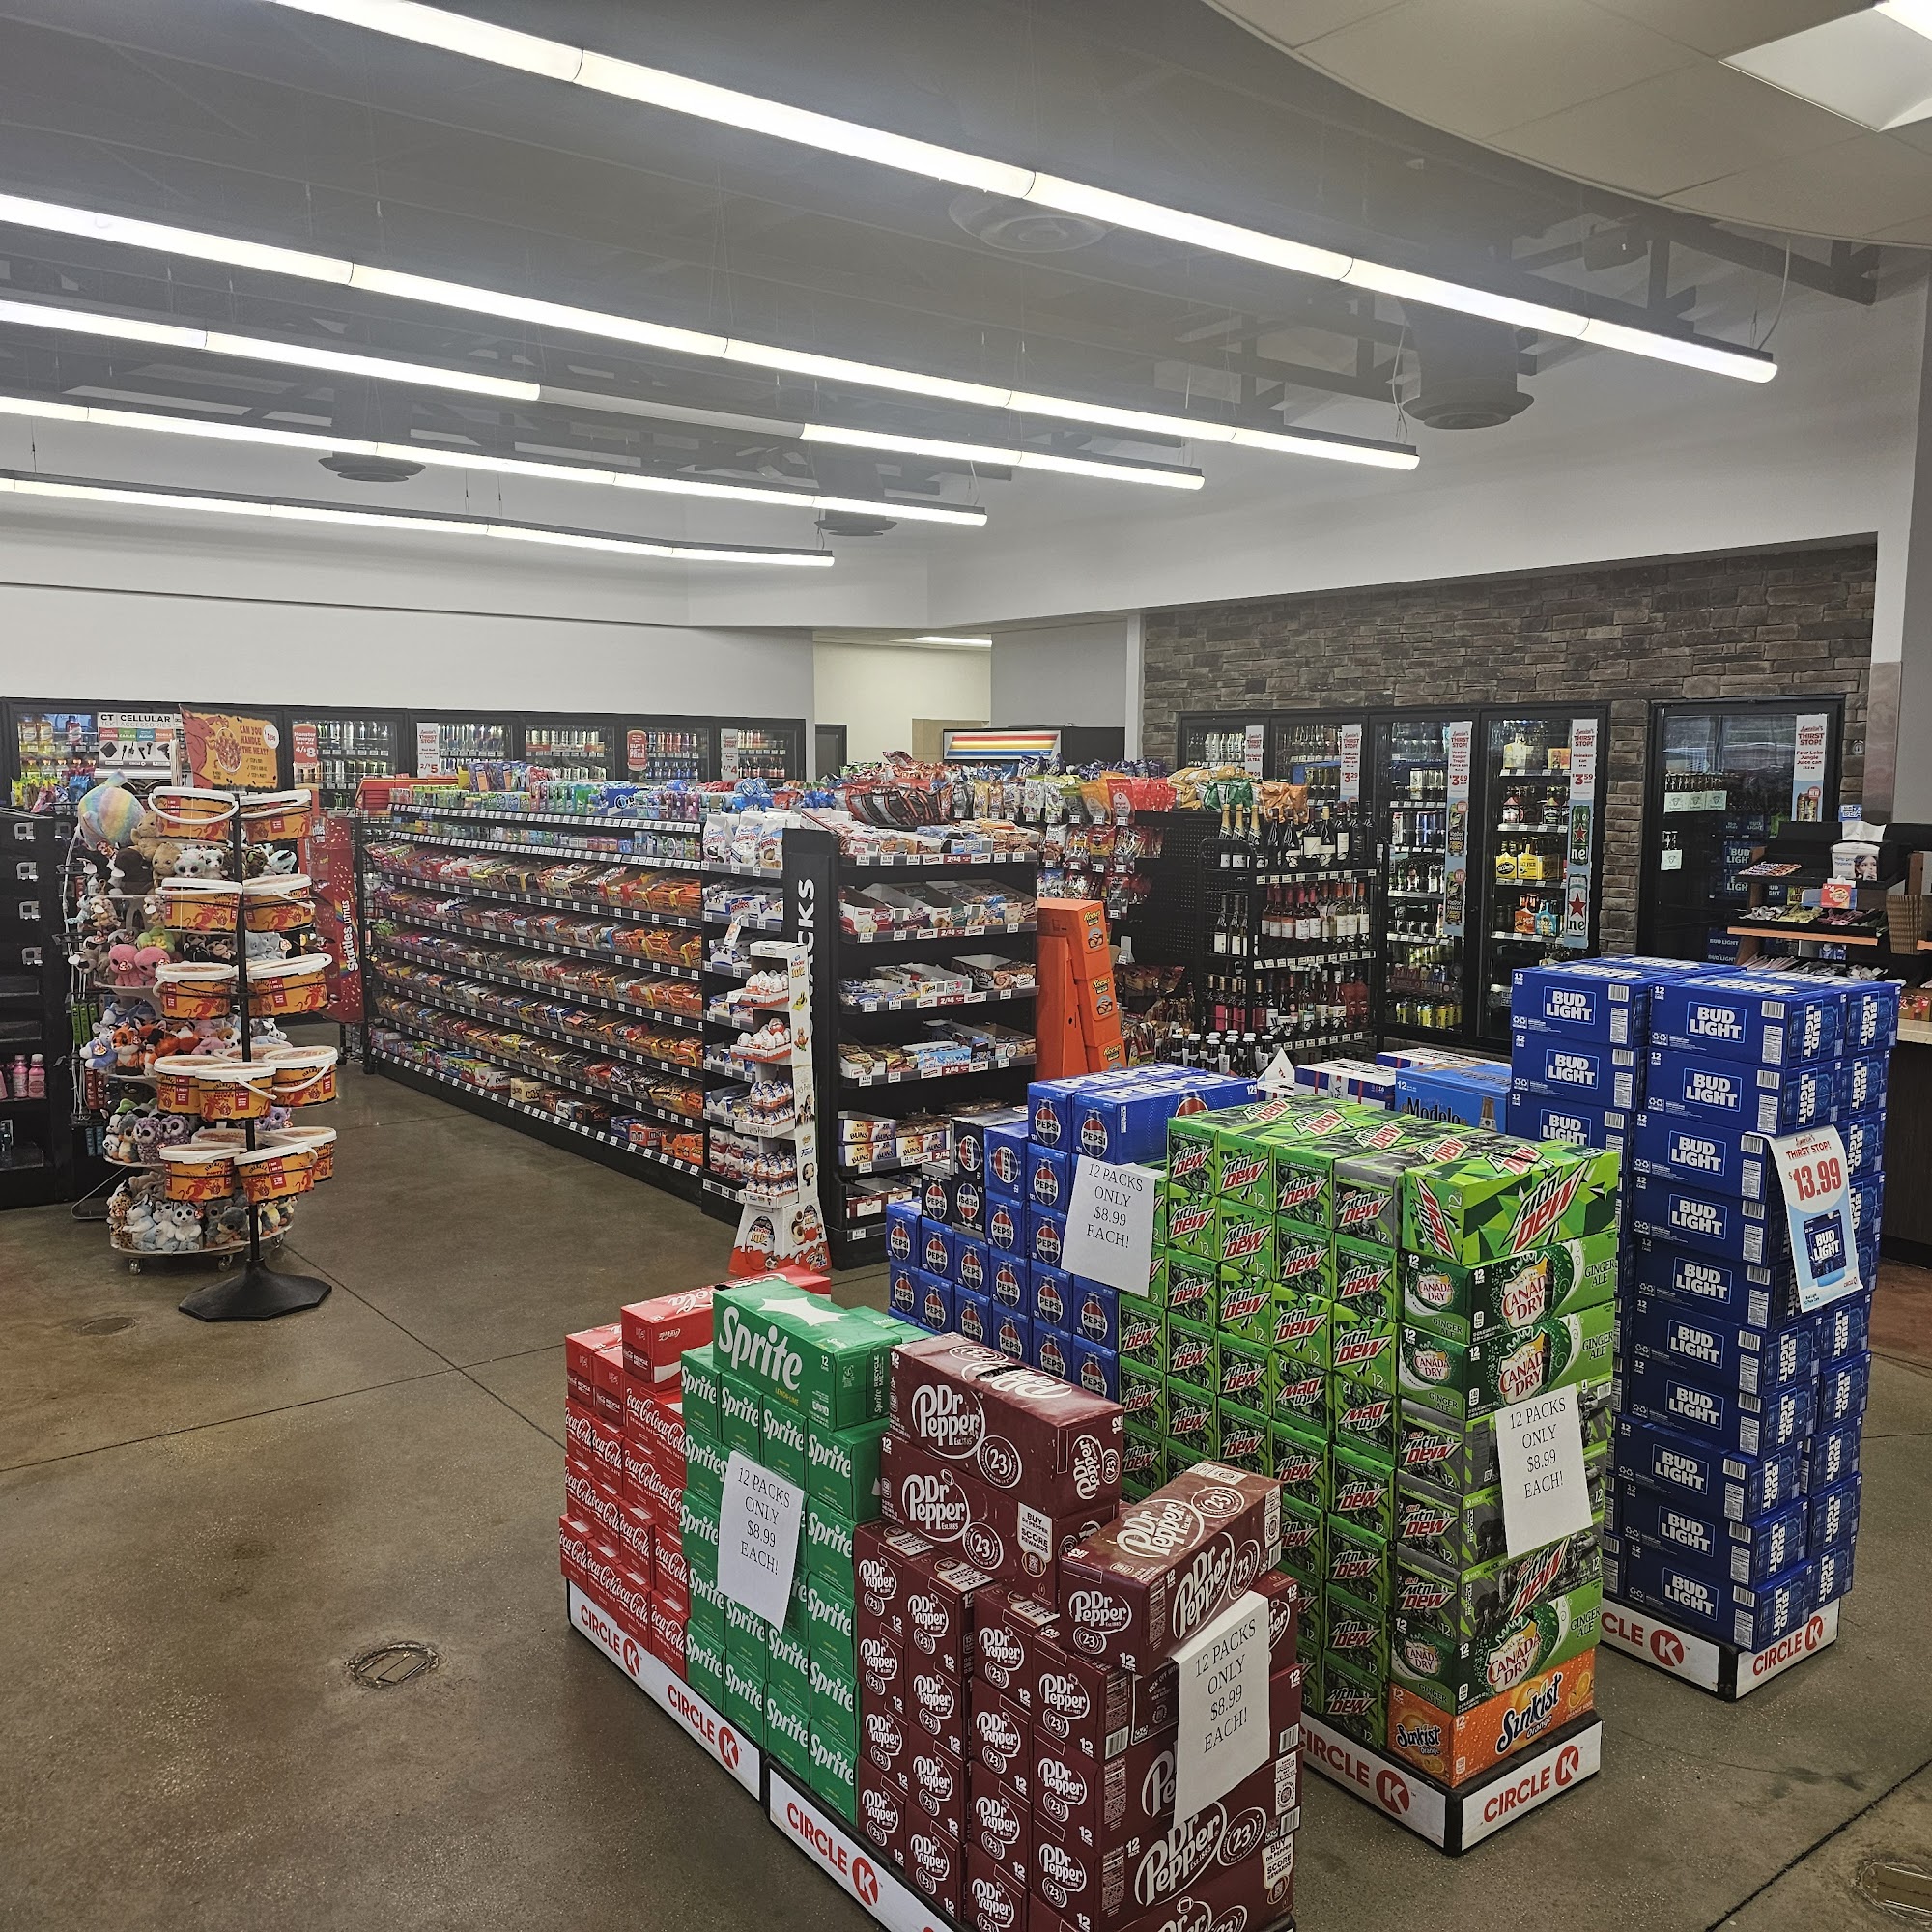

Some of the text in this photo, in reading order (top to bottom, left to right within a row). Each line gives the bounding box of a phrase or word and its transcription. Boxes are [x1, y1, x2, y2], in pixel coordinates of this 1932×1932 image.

[120, 714, 171, 723] CELLULAR
[1731, 848, 1749, 857] BUD
[343, 924, 359, 972] Skittles
[1551, 990, 1586, 1009] BUD
[1654, 986, 1665, 996] 12
[1546, 1001, 1593, 1022] LIGHT
[1696, 1006, 1736, 1026] BUD
[1689, 1019, 1742, 1041] LIGHT
[1804, 1005, 1814, 1059] LIGHT
[1812, 1010, 1822, 1049] BUD
[1048, 1064, 1189, 1089] PEPSI
[1096, 1073, 1238, 1099] PEPSI
[1407, 1097, 1460, 1124] Modelo
[1037, 1119, 1059, 1133] PEPSI
[1083, 1131, 1106, 1146] PEPSI
[1786, 1141, 1832, 1160] THIRST STOP!
[1088, 1162, 1144, 1192] 12 PACKS
[1789, 1157, 1842, 1201] $13.99
[1094, 1186, 1131, 1208] ONLY
[1254, 1193, 1264, 1207] 12
[1094, 1206, 1126, 1227] $8.99
[892, 1236, 909, 1248] PEPSI
[1087, 1223, 1130, 1249] EACH!
[1815, 1230, 1834, 1247] BUD
[1813, 1239, 1840, 1262] LIGHT
[1584, 1260, 1616, 1280] GINGER
[1592, 1273, 1608, 1289] ALE
[1417, 1280, 1453, 1295] CANADA
[1428, 1290, 1445, 1302] DRY
[1501, 1275, 1547, 1321] CANAD
[1083, 1313, 1106, 1329] PEPSI
[1517, 1296, 1545, 1321] DRY
[1433, 1318, 1463, 1333] GINGER
[718, 1306, 803, 1391] Sprite
[821, 1355, 830, 1366] 12
[681, 1365, 717, 1405] Sprite
[775, 1387, 800, 1406] LEMON-LIME
[936, 1385, 964, 1417] Dr
[1510, 1397, 1567, 1431] 12 PACKS
[912, 1384, 980, 1447] Pepper
[1521, 1424, 1557, 1450] ONLY
[808, 1434, 853, 1479] Sprite
[991, 1448, 1008, 1475] 23
[1526, 1451, 1557, 1473] $8.99
[737, 1466, 791, 1510] 12 PACKS
[1523, 1471, 1564, 1499] EACH!
[745, 1496, 781, 1526] ONLY
[1027, 1511, 1044, 1524] BUY
[746, 1522, 777, 1548] $8.99
[1021, 1527, 1049, 1548] SCORE
[1021, 1537, 1050, 1555] REWARDS
[740, 1541, 780, 1577] EACH!
[1664, 1585, 1716, 1615] LIGHT
[1671, 1576, 1708, 1599] BUD
[1069, 1591, 1127, 1627] Pepper
[581, 1605, 621, 1657] CIRCLE
[1602, 1612, 1644, 1644] CLE
[1120, 1651, 1136, 1667] 12
[1195, 1656, 1209, 1678] 12
[1212, 1618, 1256, 1666] PACKS
[1487, 1634, 1543, 1685] CANADA
[1752, 1634, 1803, 1676] CIRCLE
[1208, 1654, 1246, 1696] ONLY
[1504, 1657, 1530, 1686] DRY
[725, 1664, 763, 1713] Sprite
[668, 1684, 715, 1744] CIRCLE
[1210, 1684, 1243, 1721] $8.99
[1496, 1671, 1564, 1756] Sunkist
[1204, 1706, 1248, 1753] EACH!
[1396, 1723, 1442, 1749] Sunkist
[1525, 1715, 1553, 1740] Orange
[810, 1733, 855, 1786] Sprite
[1483, 1766, 1550, 1823] CIRCLE
[786, 1802, 848, 1877] CIRCLE
[1136, 1816, 1221, 1907] Pepper
